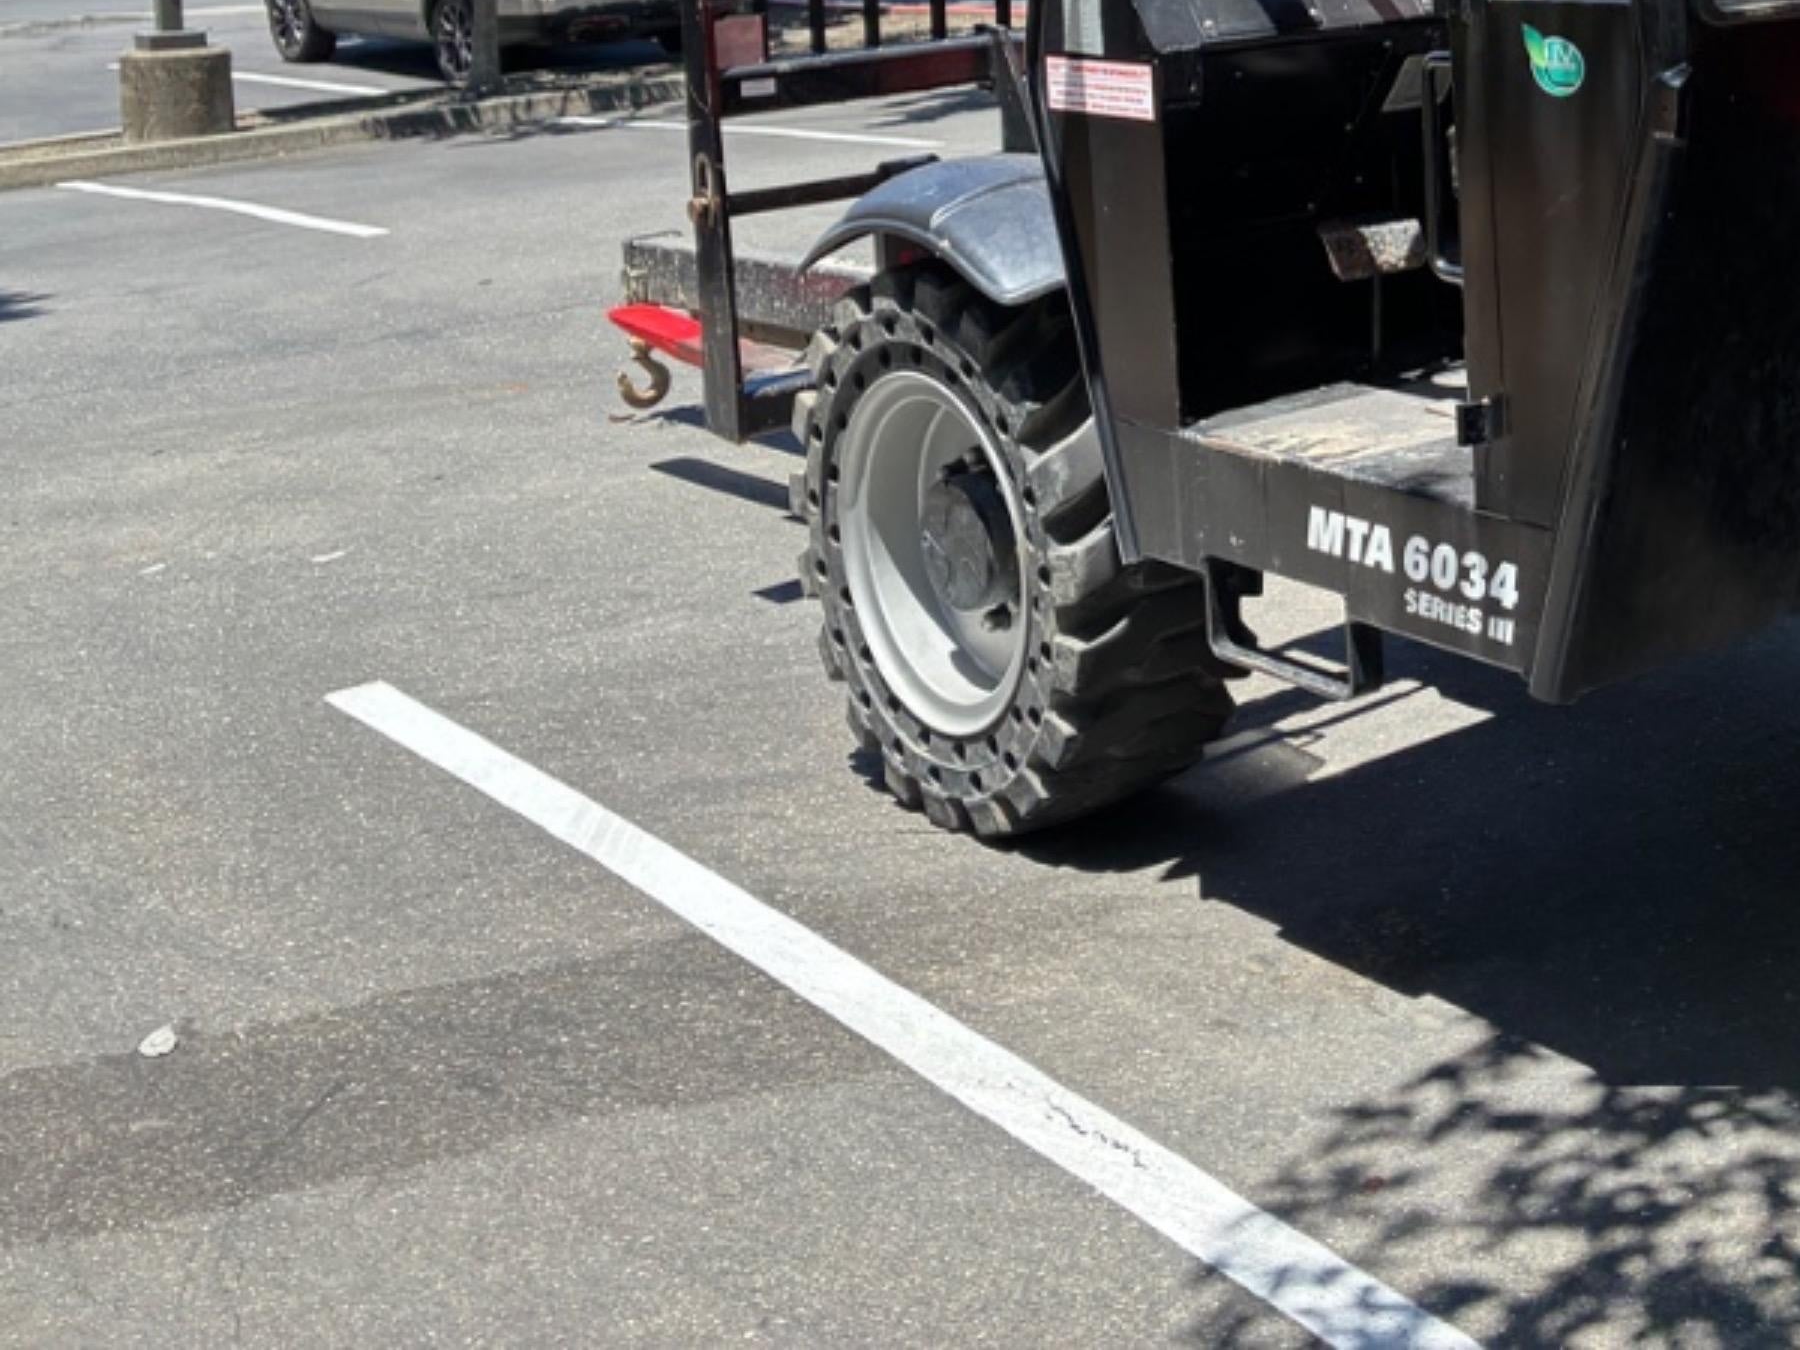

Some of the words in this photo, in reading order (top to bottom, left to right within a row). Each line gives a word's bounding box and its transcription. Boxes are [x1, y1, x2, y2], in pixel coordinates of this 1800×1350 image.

[1307, 505, 1396, 574] MTA
[1402, 533, 1520, 611] 6034
[1403, 587, 1483, 635] SERIES
[1486, 616, 1516, 646] III
